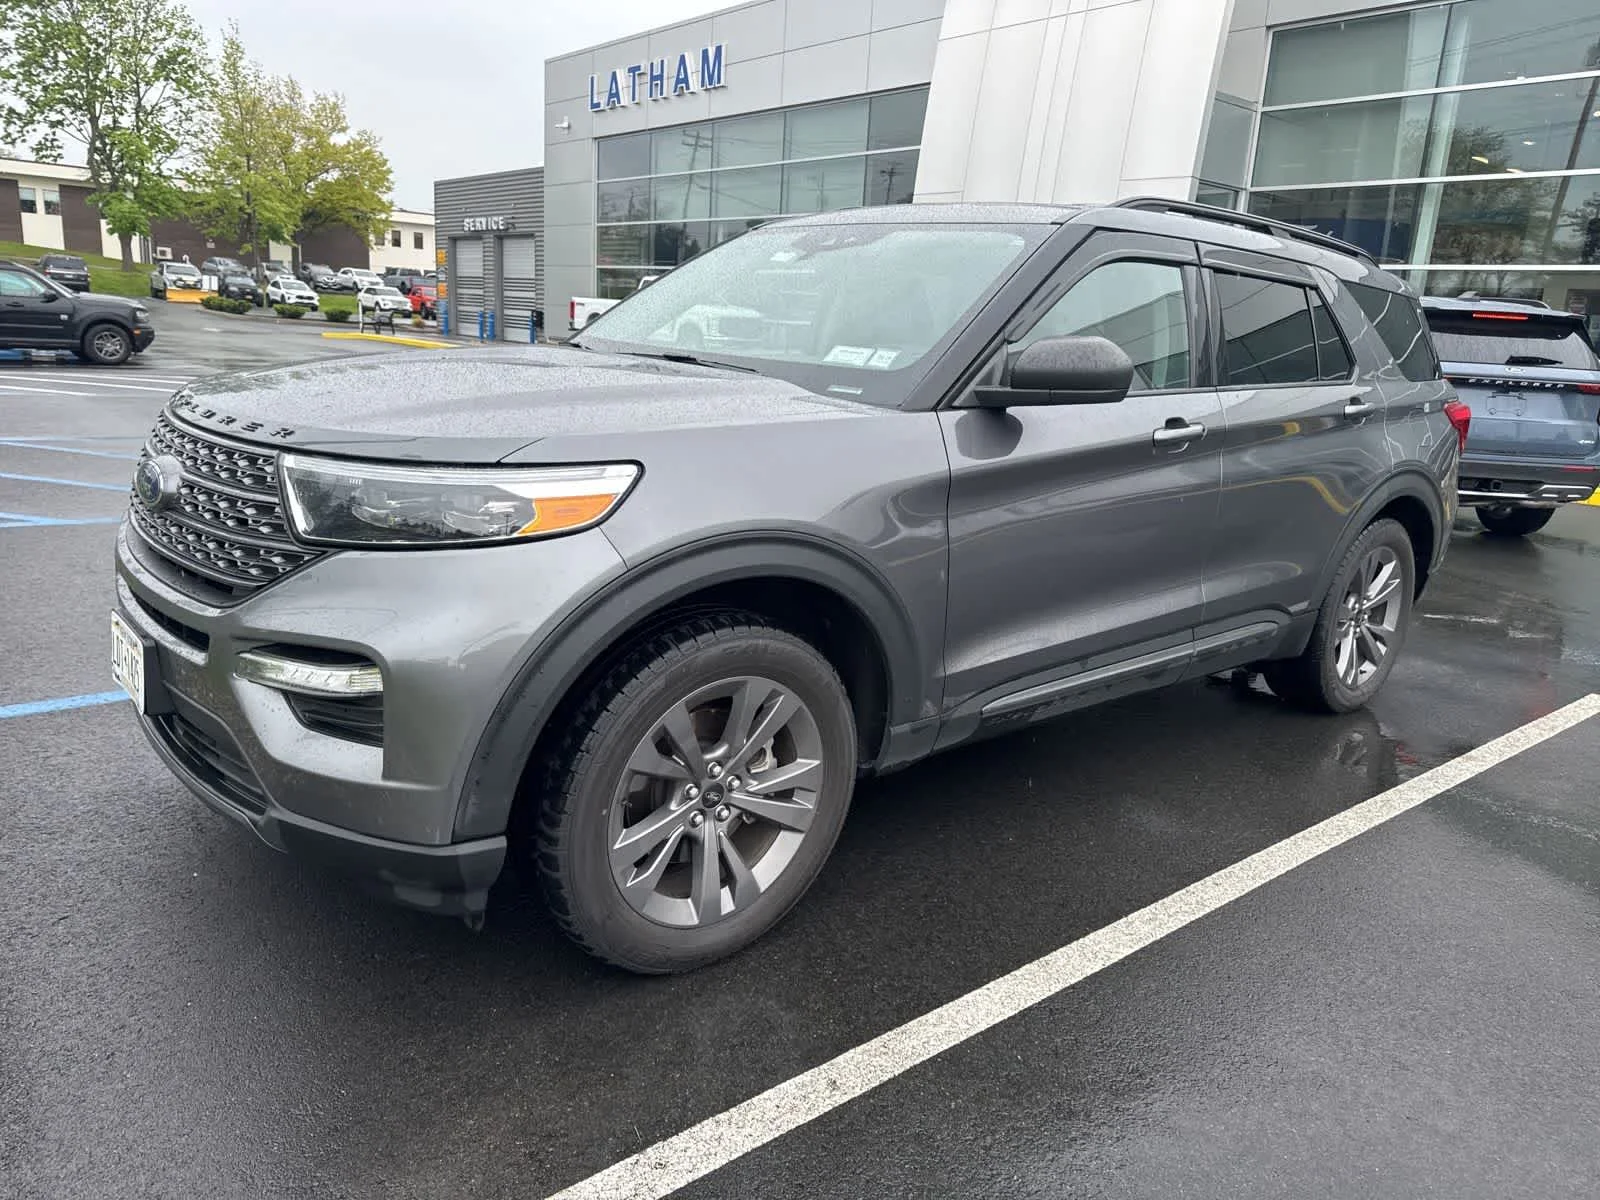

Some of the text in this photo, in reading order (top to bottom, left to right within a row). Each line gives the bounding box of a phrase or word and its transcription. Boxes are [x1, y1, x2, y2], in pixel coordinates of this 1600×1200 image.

[589, 43, 727, 112] LATHAM
[463, 216, 505, 231] SERVICE
[1468, 378, 1565, 389] EXPLORER
